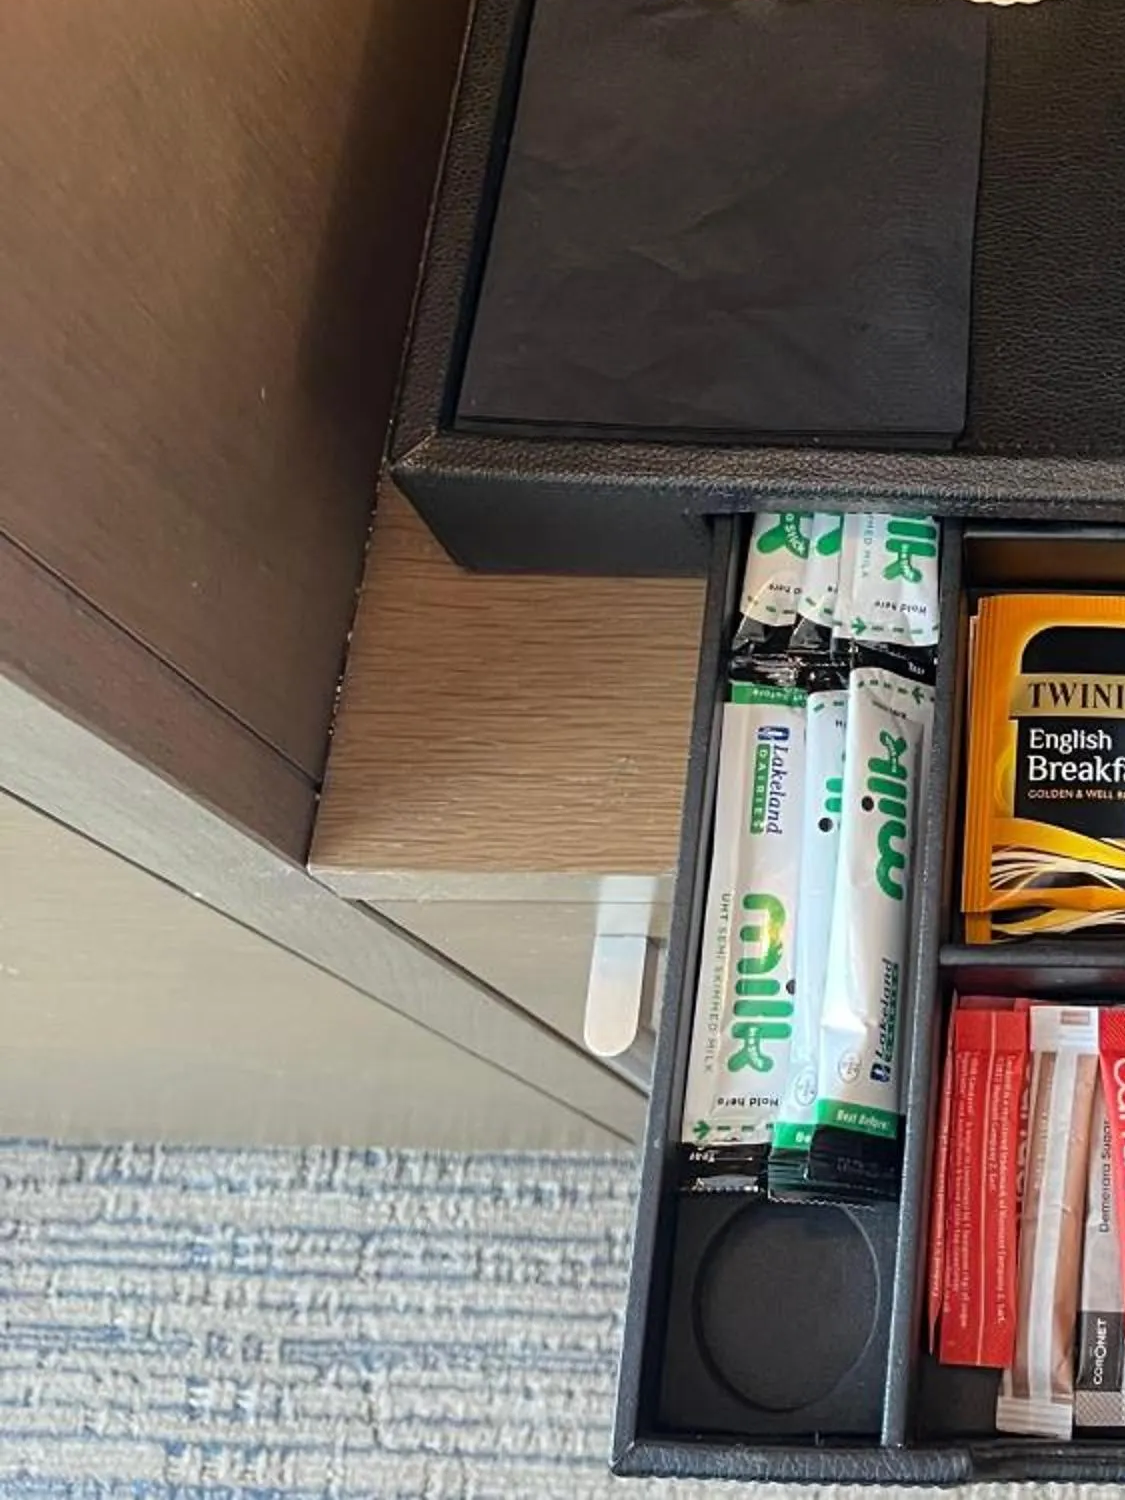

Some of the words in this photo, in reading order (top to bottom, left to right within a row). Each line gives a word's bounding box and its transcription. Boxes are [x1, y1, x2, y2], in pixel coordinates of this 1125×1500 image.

[899, 601, 927, 615] Hold
[1029, 728, 1113, 754] English
[753, 748, 769, 828] DAIRIES
[766, 744, 789, 835] Lakeland
[1027, 788, 1074, 800] GOLDEN
[1076, 789, 1083, 799] &
[1086, 789, 1114, 801] WELL
[861, 729, 908, 901] milk
[719, 892, 731, 922] UHT
[708, 965, 724, 1031] SKIMMED
[727, 893, 796, 1073] milk
[874, 957, 894, 1060] Lakeland
[703, 1037, 718, 1075] MILK
[717, 1096, 746, 1107] here
[749, 1097, 779, 1107] Hold
[795, 1131, 812, 1144] Be
[1098, 1163, 1111, 1233] Demerara
